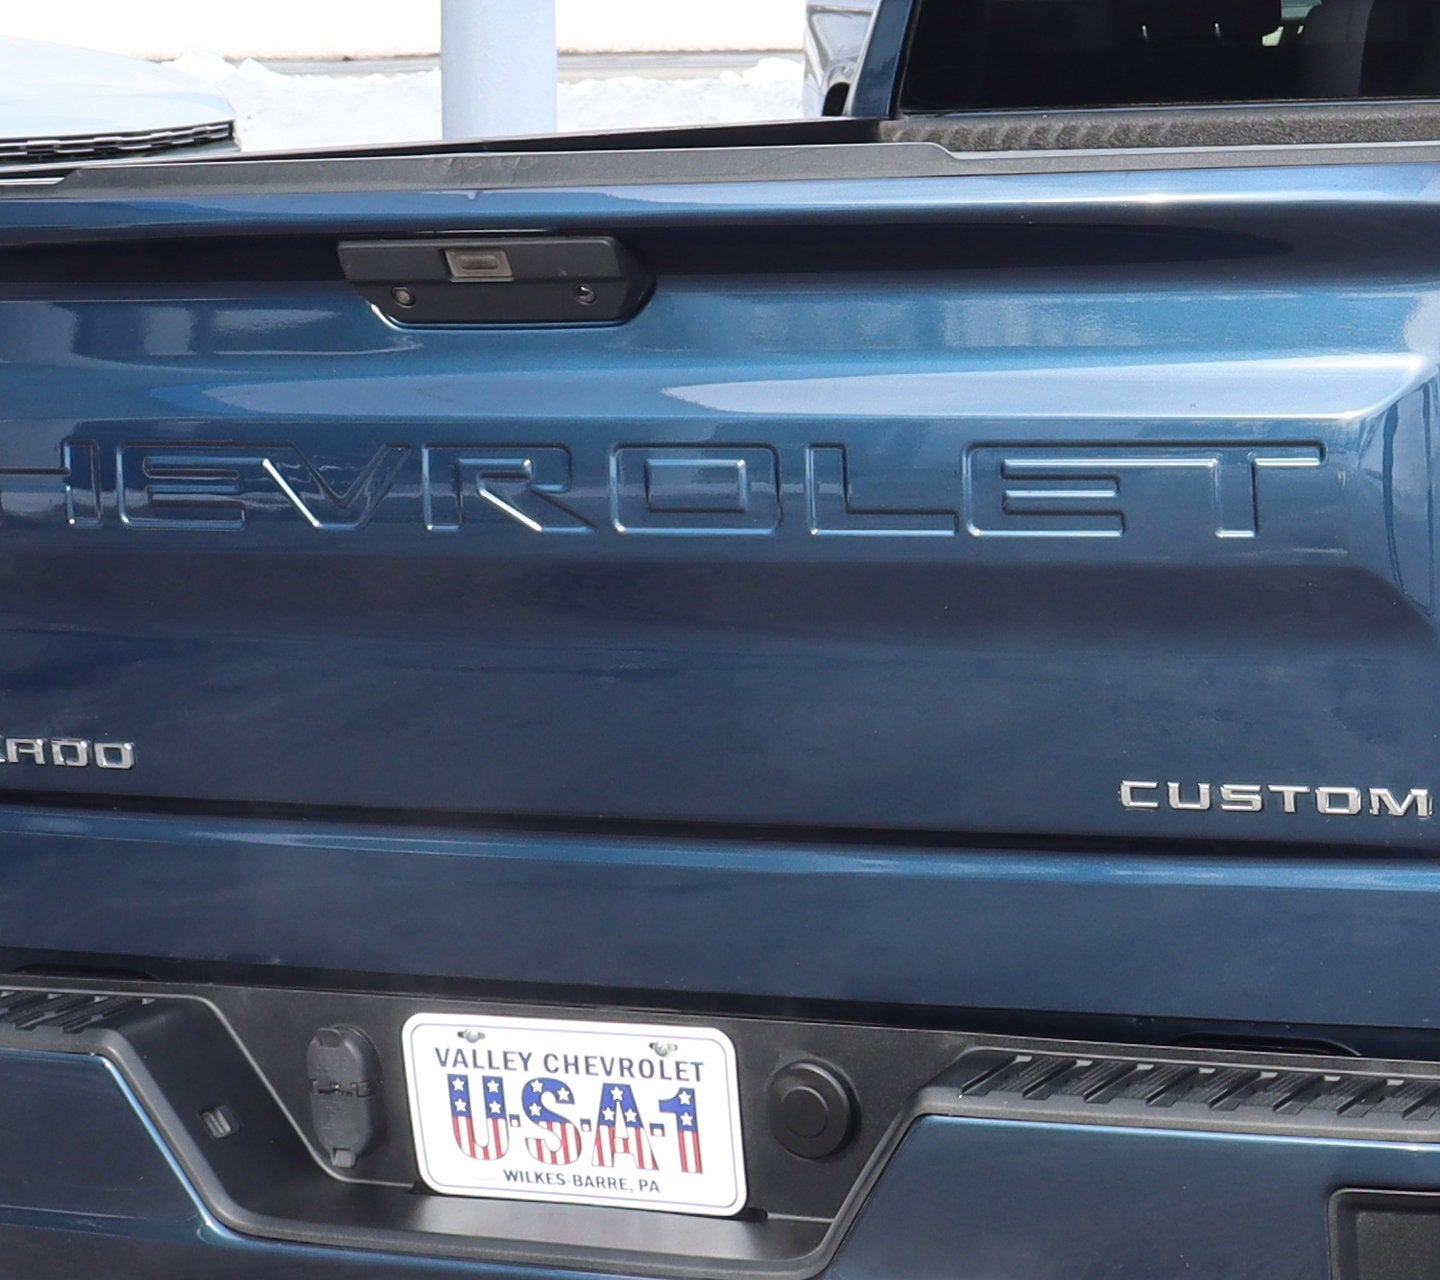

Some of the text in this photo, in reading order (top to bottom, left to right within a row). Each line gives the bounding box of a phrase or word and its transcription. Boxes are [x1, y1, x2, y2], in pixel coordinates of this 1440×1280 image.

[1118, 778, 1434, 819] CUSTOM
[434, 1046, 705, 1083] VALLEY CHEVROLET
[502, 1168, 661, 1193] WILKES-BARRE, PA
